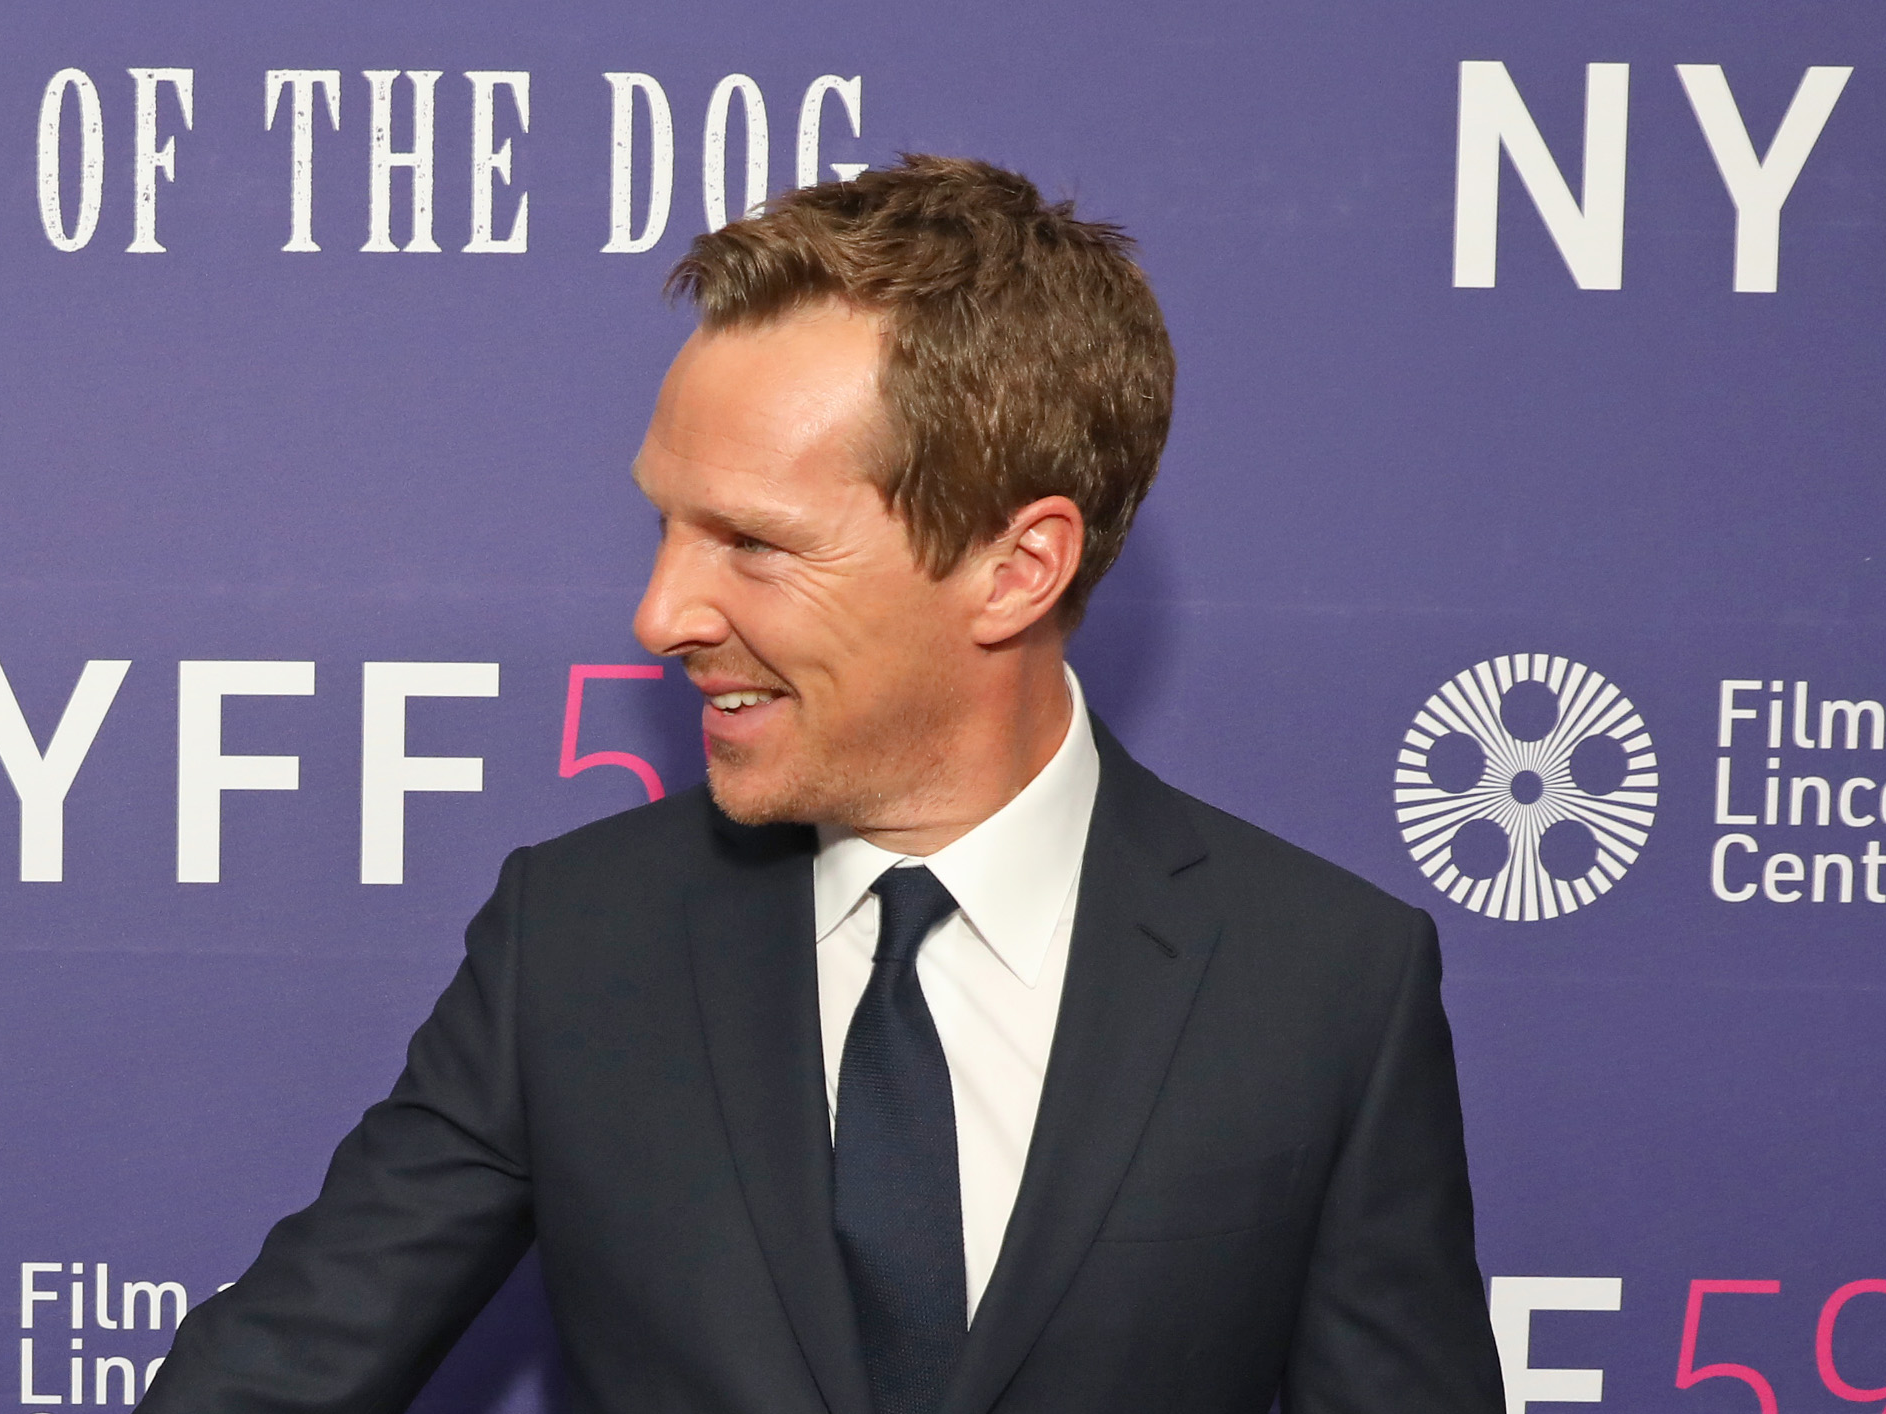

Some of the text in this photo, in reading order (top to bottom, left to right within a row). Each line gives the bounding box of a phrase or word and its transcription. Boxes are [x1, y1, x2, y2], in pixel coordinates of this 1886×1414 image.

[37, 67, 195, 254] OF
[264, 69, 530, 254] THE
[1717, 679, 1885, 750] Film
[1715, 757, 1886, 827] Linc
[21, 1262, 188, 1330] Film
